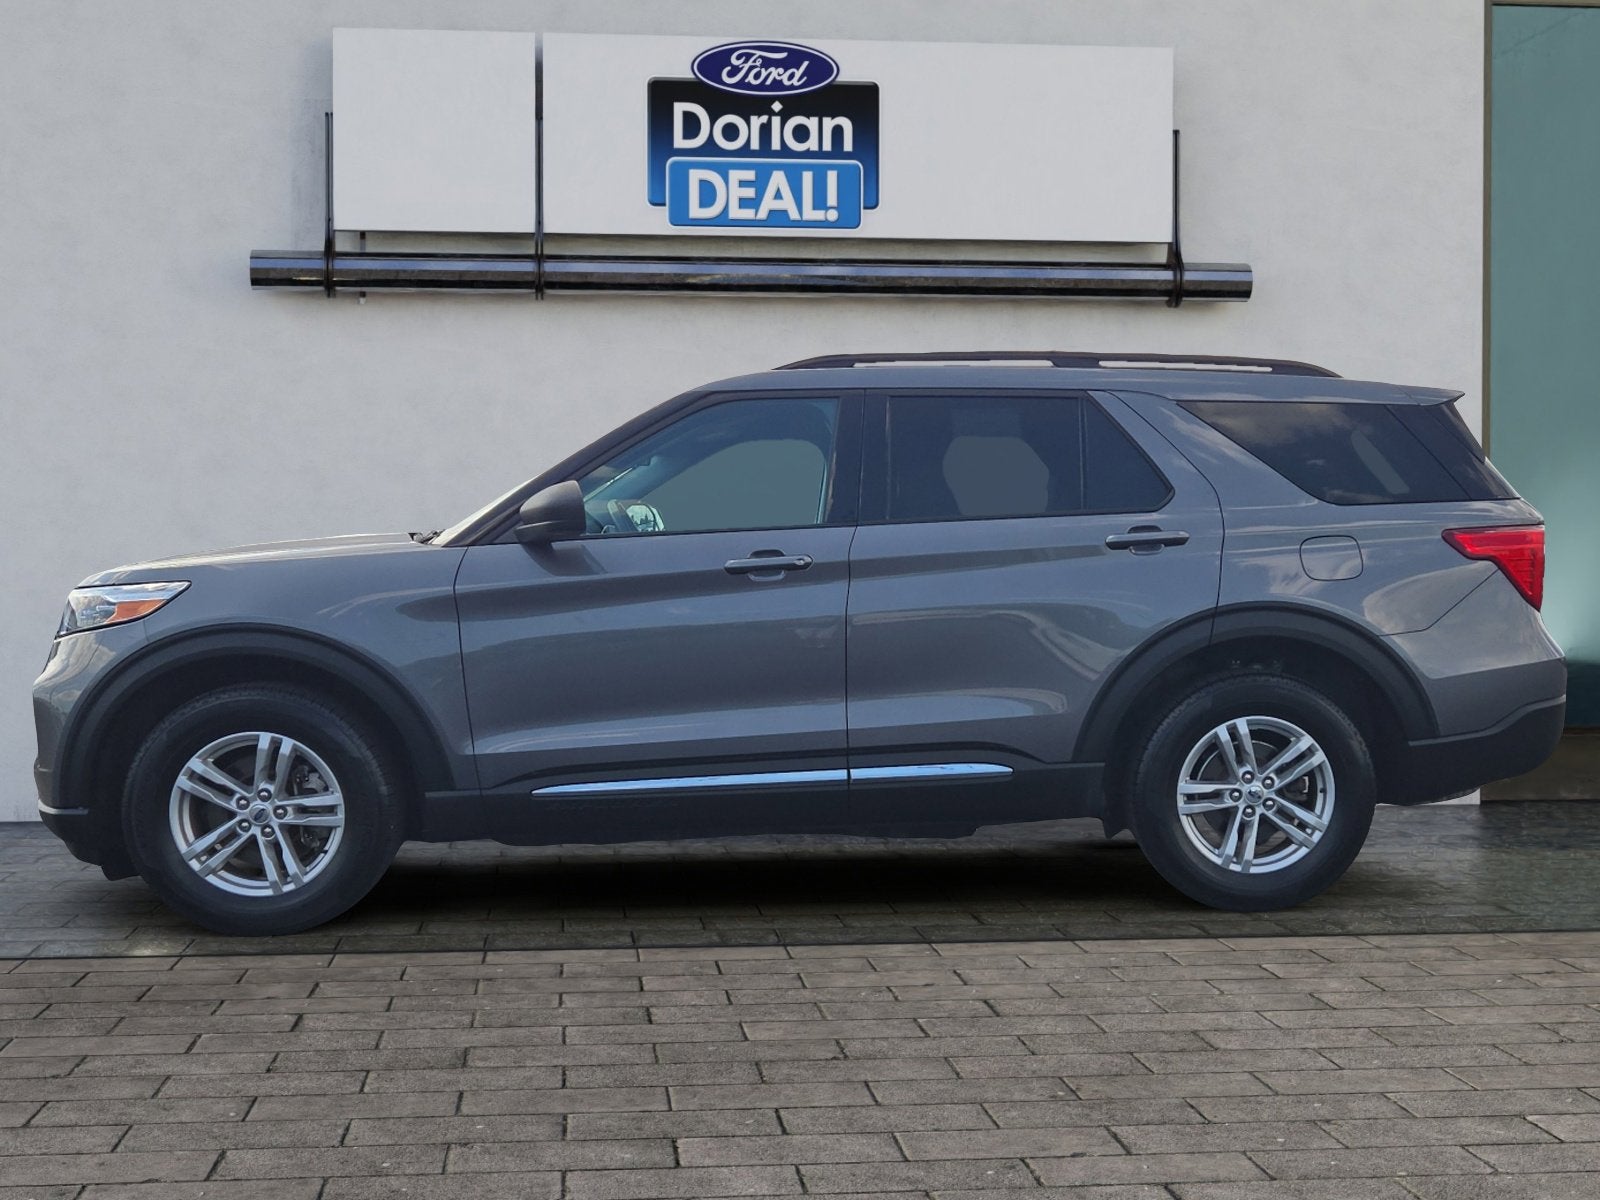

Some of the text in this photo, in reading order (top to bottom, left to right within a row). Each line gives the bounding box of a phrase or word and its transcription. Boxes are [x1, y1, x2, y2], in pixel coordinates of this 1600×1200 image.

[721, 49, 810, 86] Ford
[673, 101, 853, 152] Dorian
[688, 169, 840, 222] DEAL!
